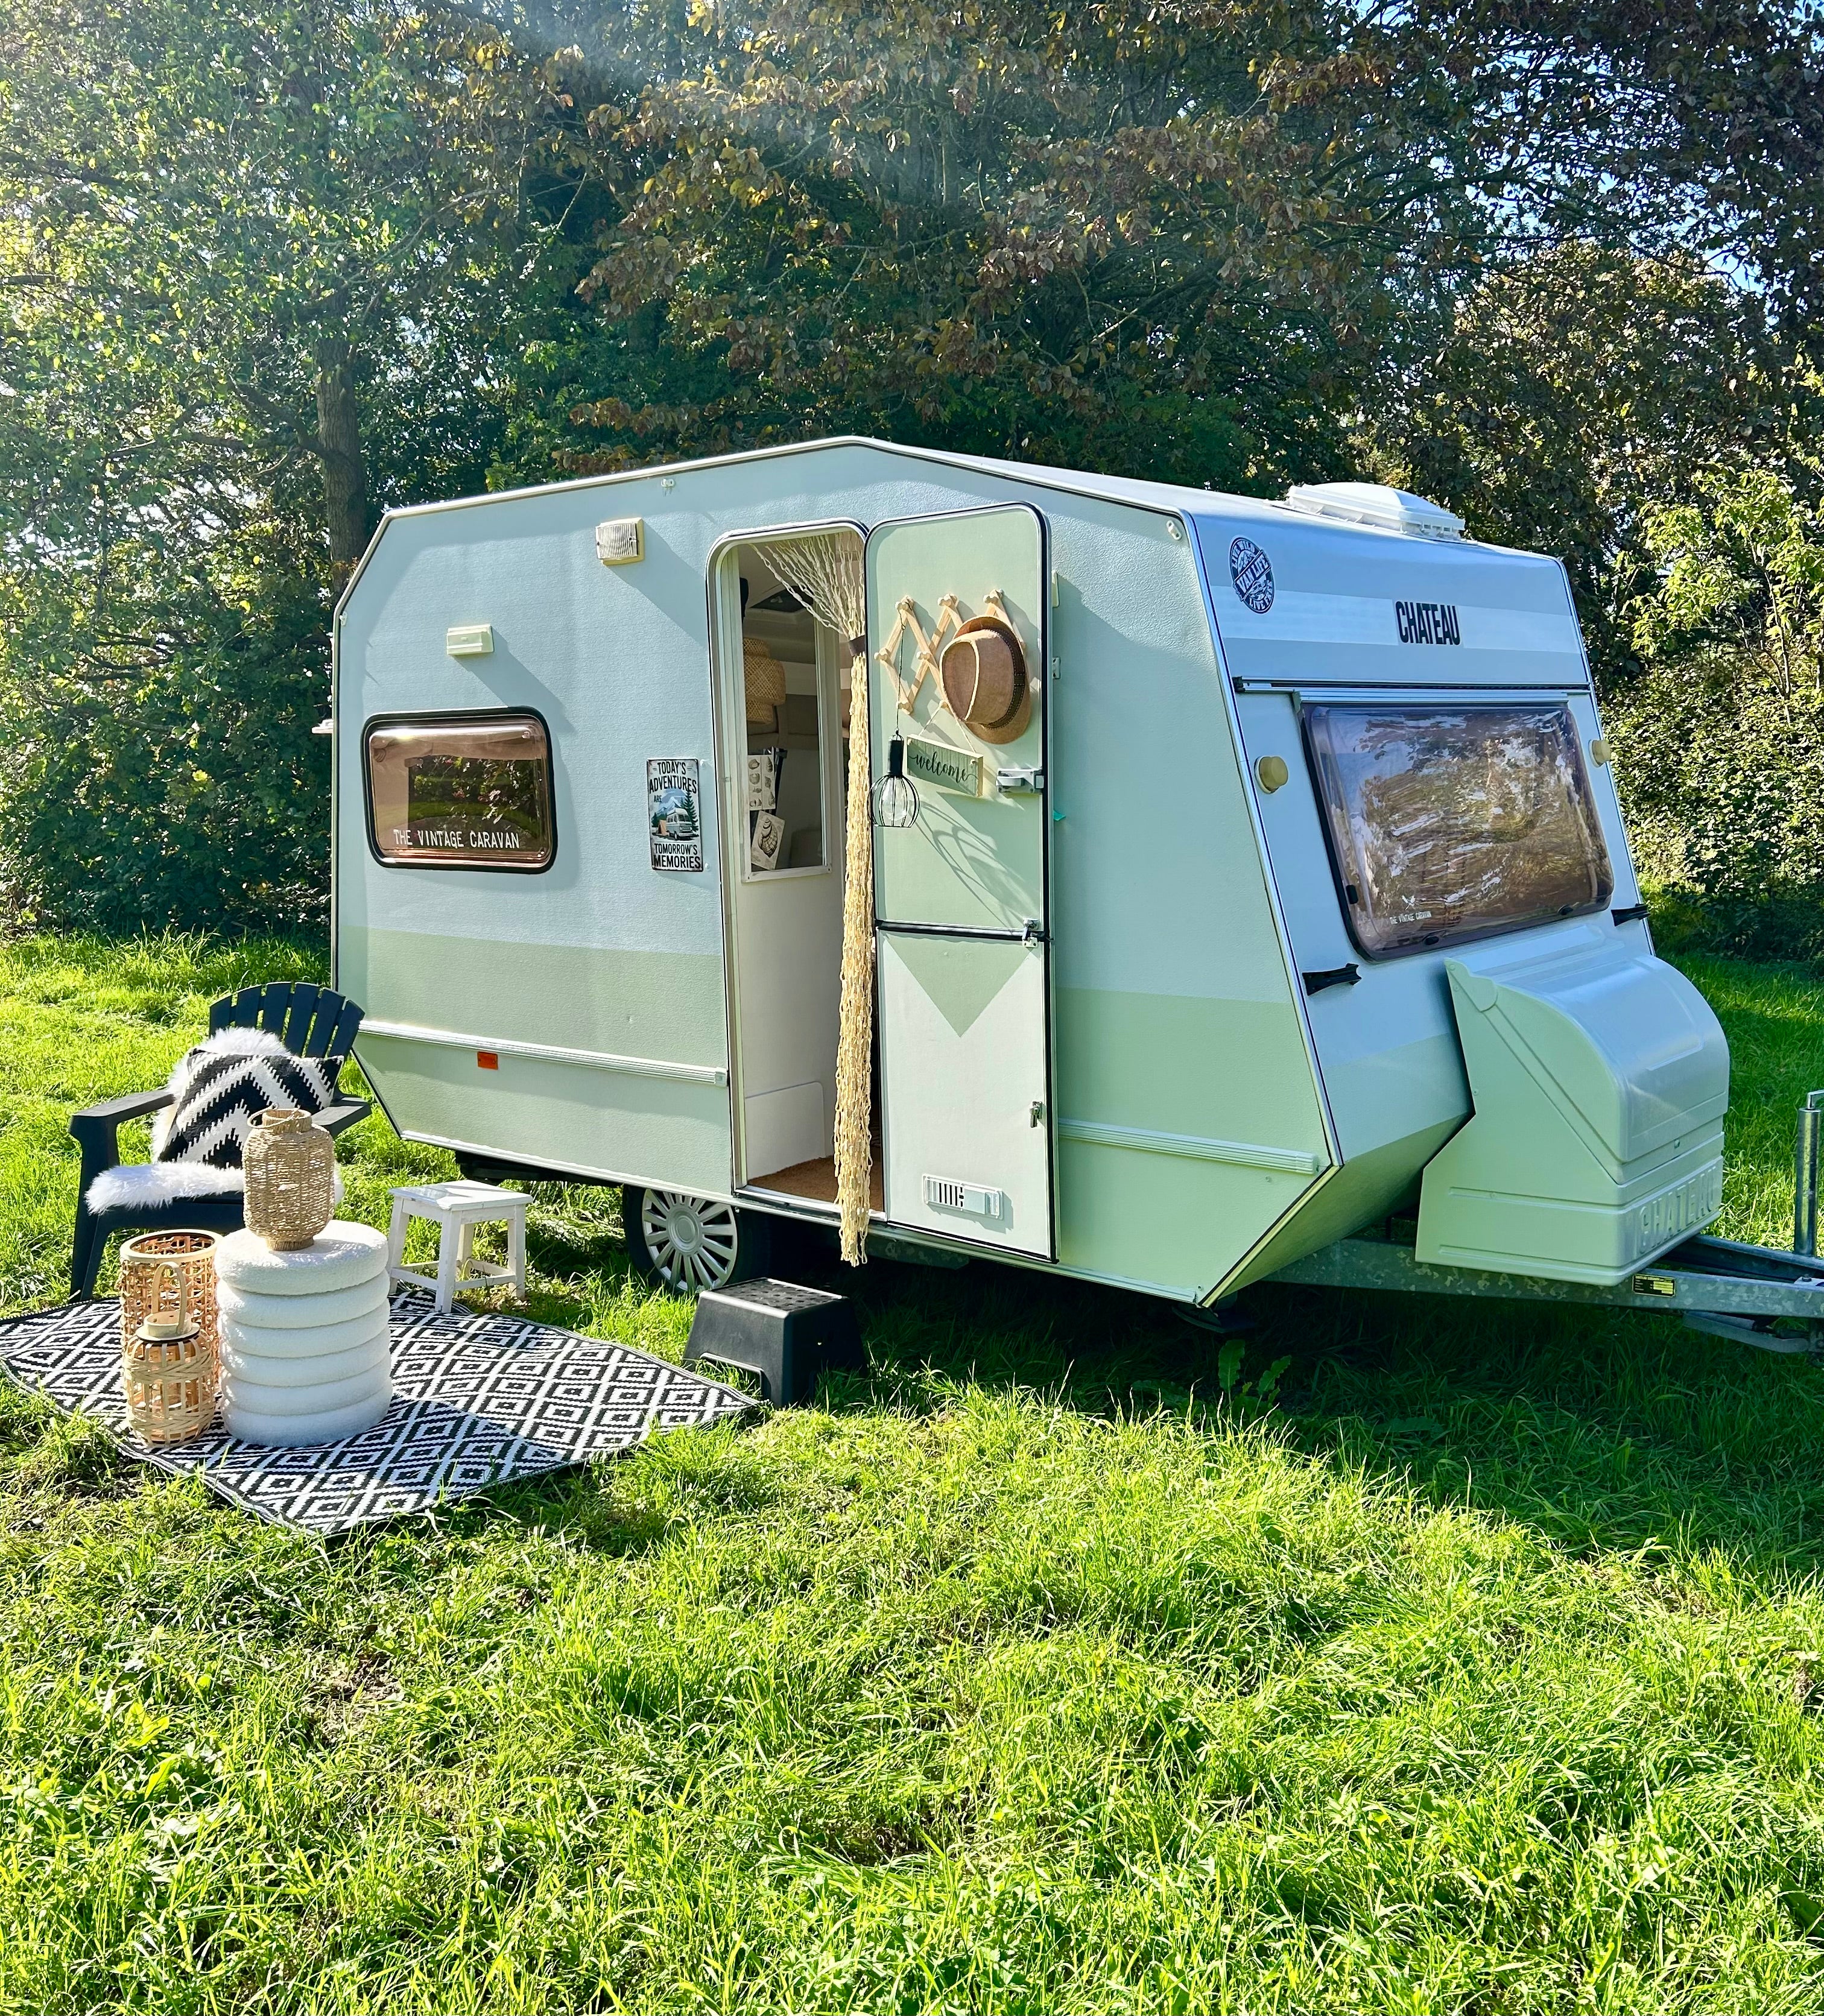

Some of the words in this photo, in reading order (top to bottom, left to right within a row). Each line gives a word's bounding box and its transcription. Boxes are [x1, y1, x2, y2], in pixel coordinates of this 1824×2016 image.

[1236, 567, 1256, 593] VAN
[1250, 554, 1270, 578] LIFE
[1395, 601, 1460, 645] CHATEAU
[657, 761, 686, 776] TODAY'S
[908, 751, 979, 783] welcome
[649, 775, 697, 794] ADVENTURES
[653, 795, 662, 803] ARE
[393, 829, 413, 845] THE
[417, 830, 464, 848] VINTAGE
[469, 830, 520, 848] CARAVAN
[654, 843, 698, 855] TOMORROW'S
[653, 855, 701, 869] MEMORIES
[1639, 1166, 1717, 1255] CHATEAU
